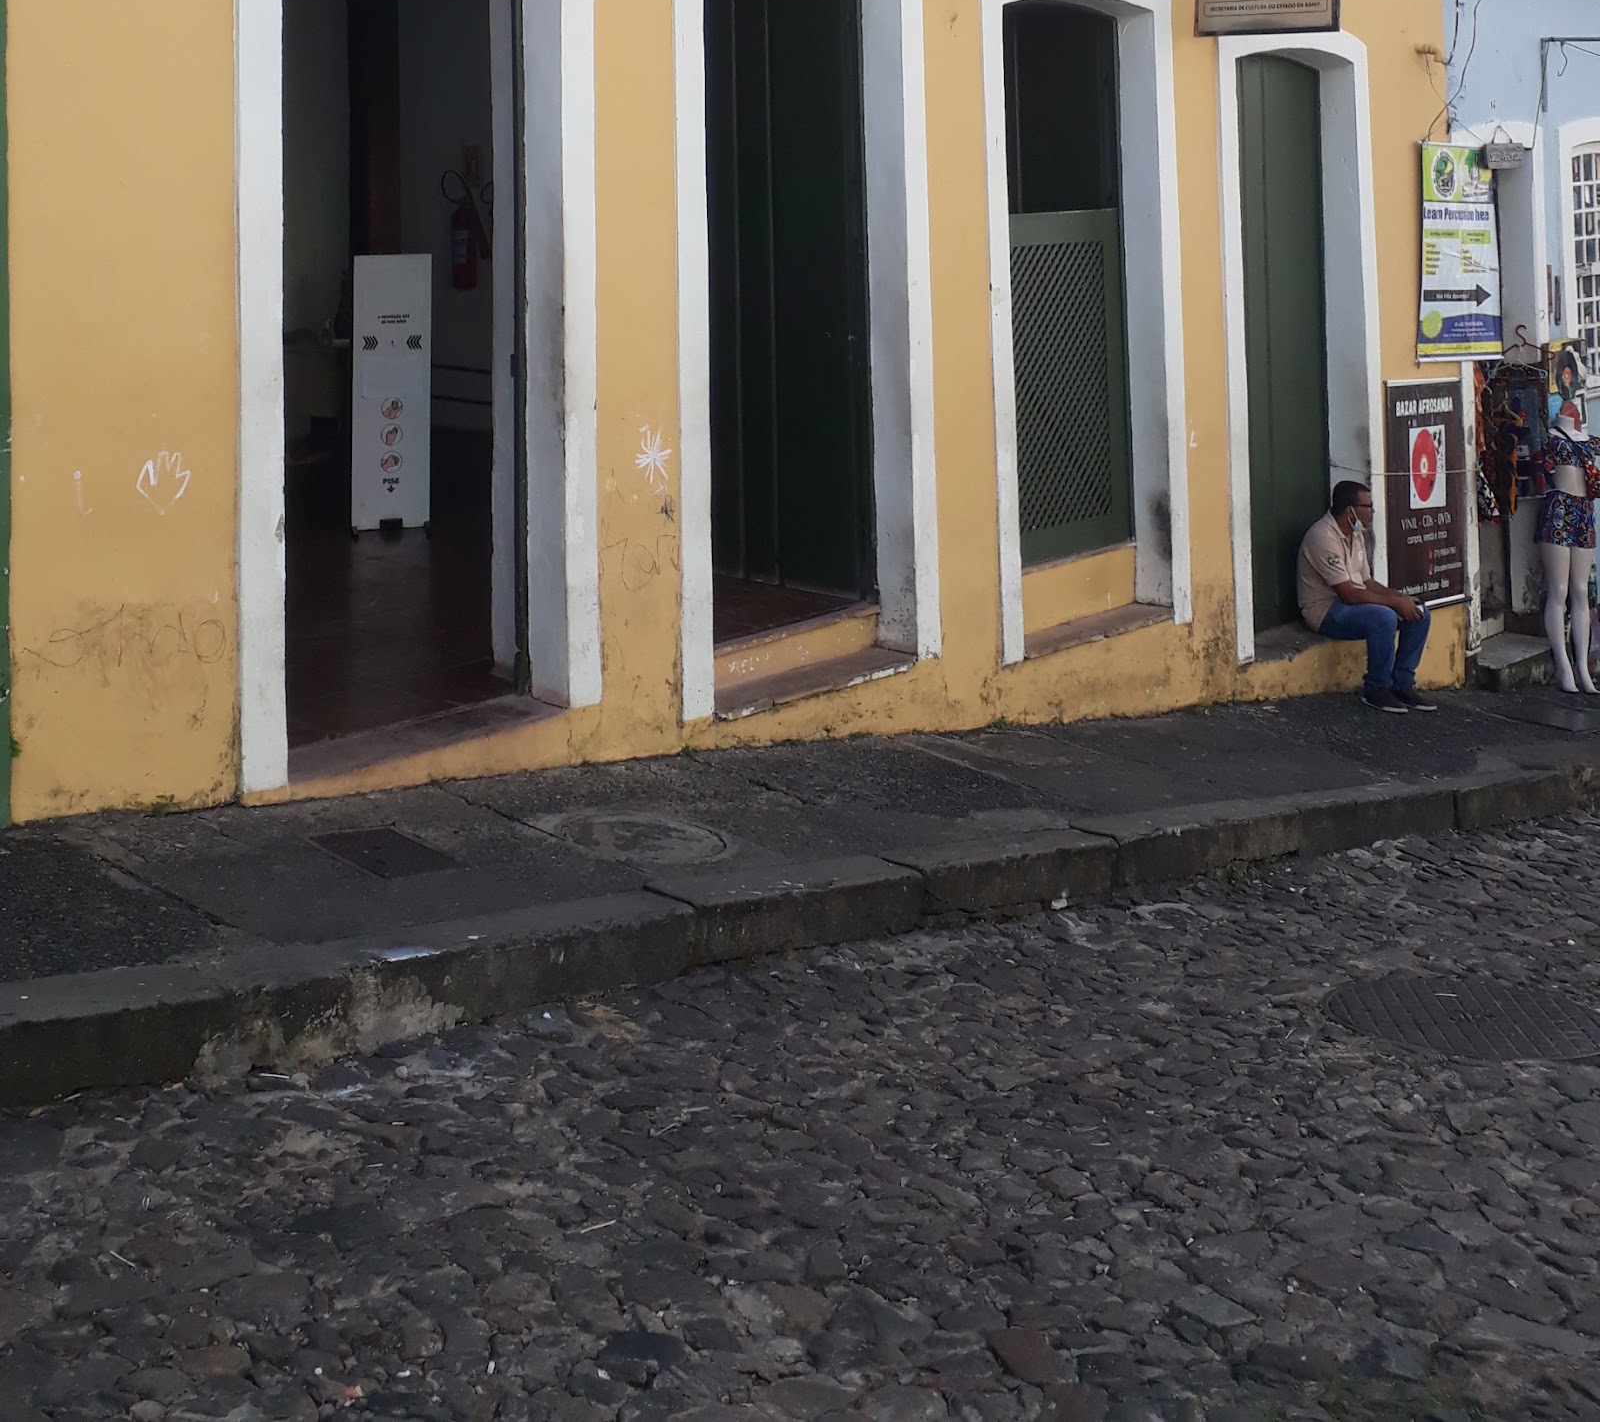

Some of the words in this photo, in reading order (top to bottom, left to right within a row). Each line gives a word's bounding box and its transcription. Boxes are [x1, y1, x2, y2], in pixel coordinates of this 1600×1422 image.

[1395, 399, 1418, 417] BAZAR
[1418, 396, 1454, 415] AFROSAMBA
[1422, 514, 1434, 528] CDs
